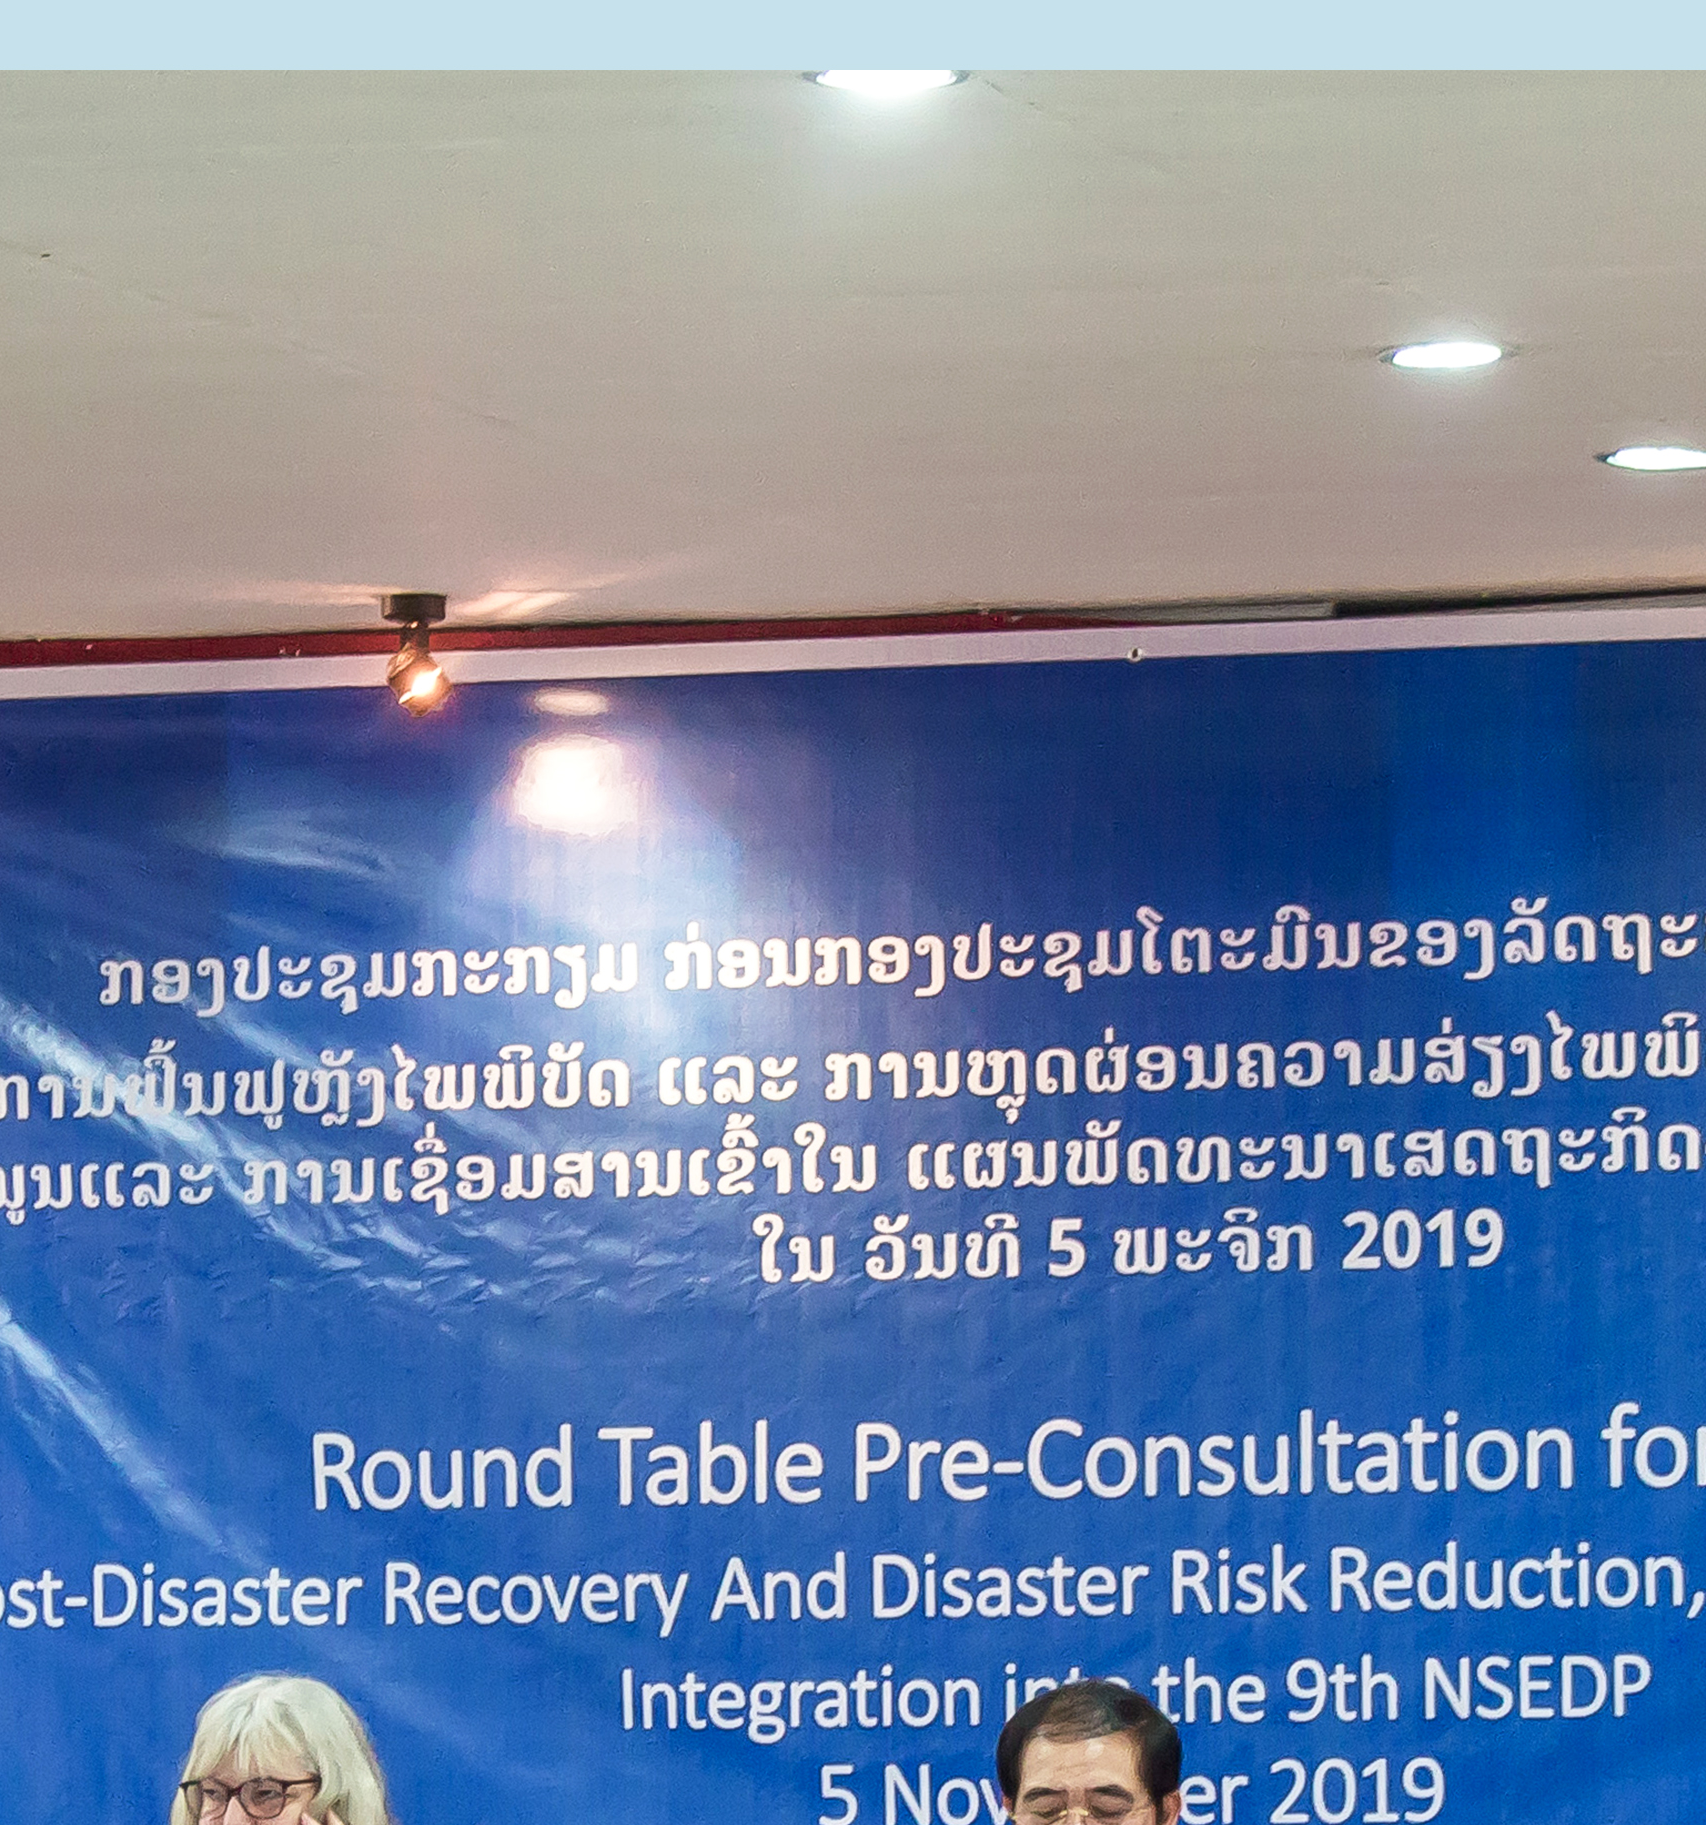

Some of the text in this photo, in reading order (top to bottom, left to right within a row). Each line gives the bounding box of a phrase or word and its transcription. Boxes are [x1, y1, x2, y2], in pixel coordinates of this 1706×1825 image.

[98, 939, 638, 1015] ກອງປະຊຸມກະກຽມ
[659, 1053, 798, 1104] ແລະ
[752, 1207, 1504, 1283] ໃນ ວັນທີ 5 ພະຈິກ 2019
[311, 1423, 574, 1511] Round
[598, 1420, 822, 1506] Table
[855, 1408, 1574, 1502] Pre-Consultation
[385, 1561, 689, 1638] Recovery
[710, 1551, 848, 1622] And
[870, 1552, 1150, 1618] Disaster
[1171, 1545, 1310, 1615] Risk
[1330, 1541, 1706, 1618] Reduction,
[622, 1664, 981, 1745] Integration
[1150, 1657, 1267, 1724] the
[1287, 1653, 1399, 1722] 9th
[1424, 1653, 1652, 1719] NSEDP
[1269, 1756, 1446, 1825] 2019
